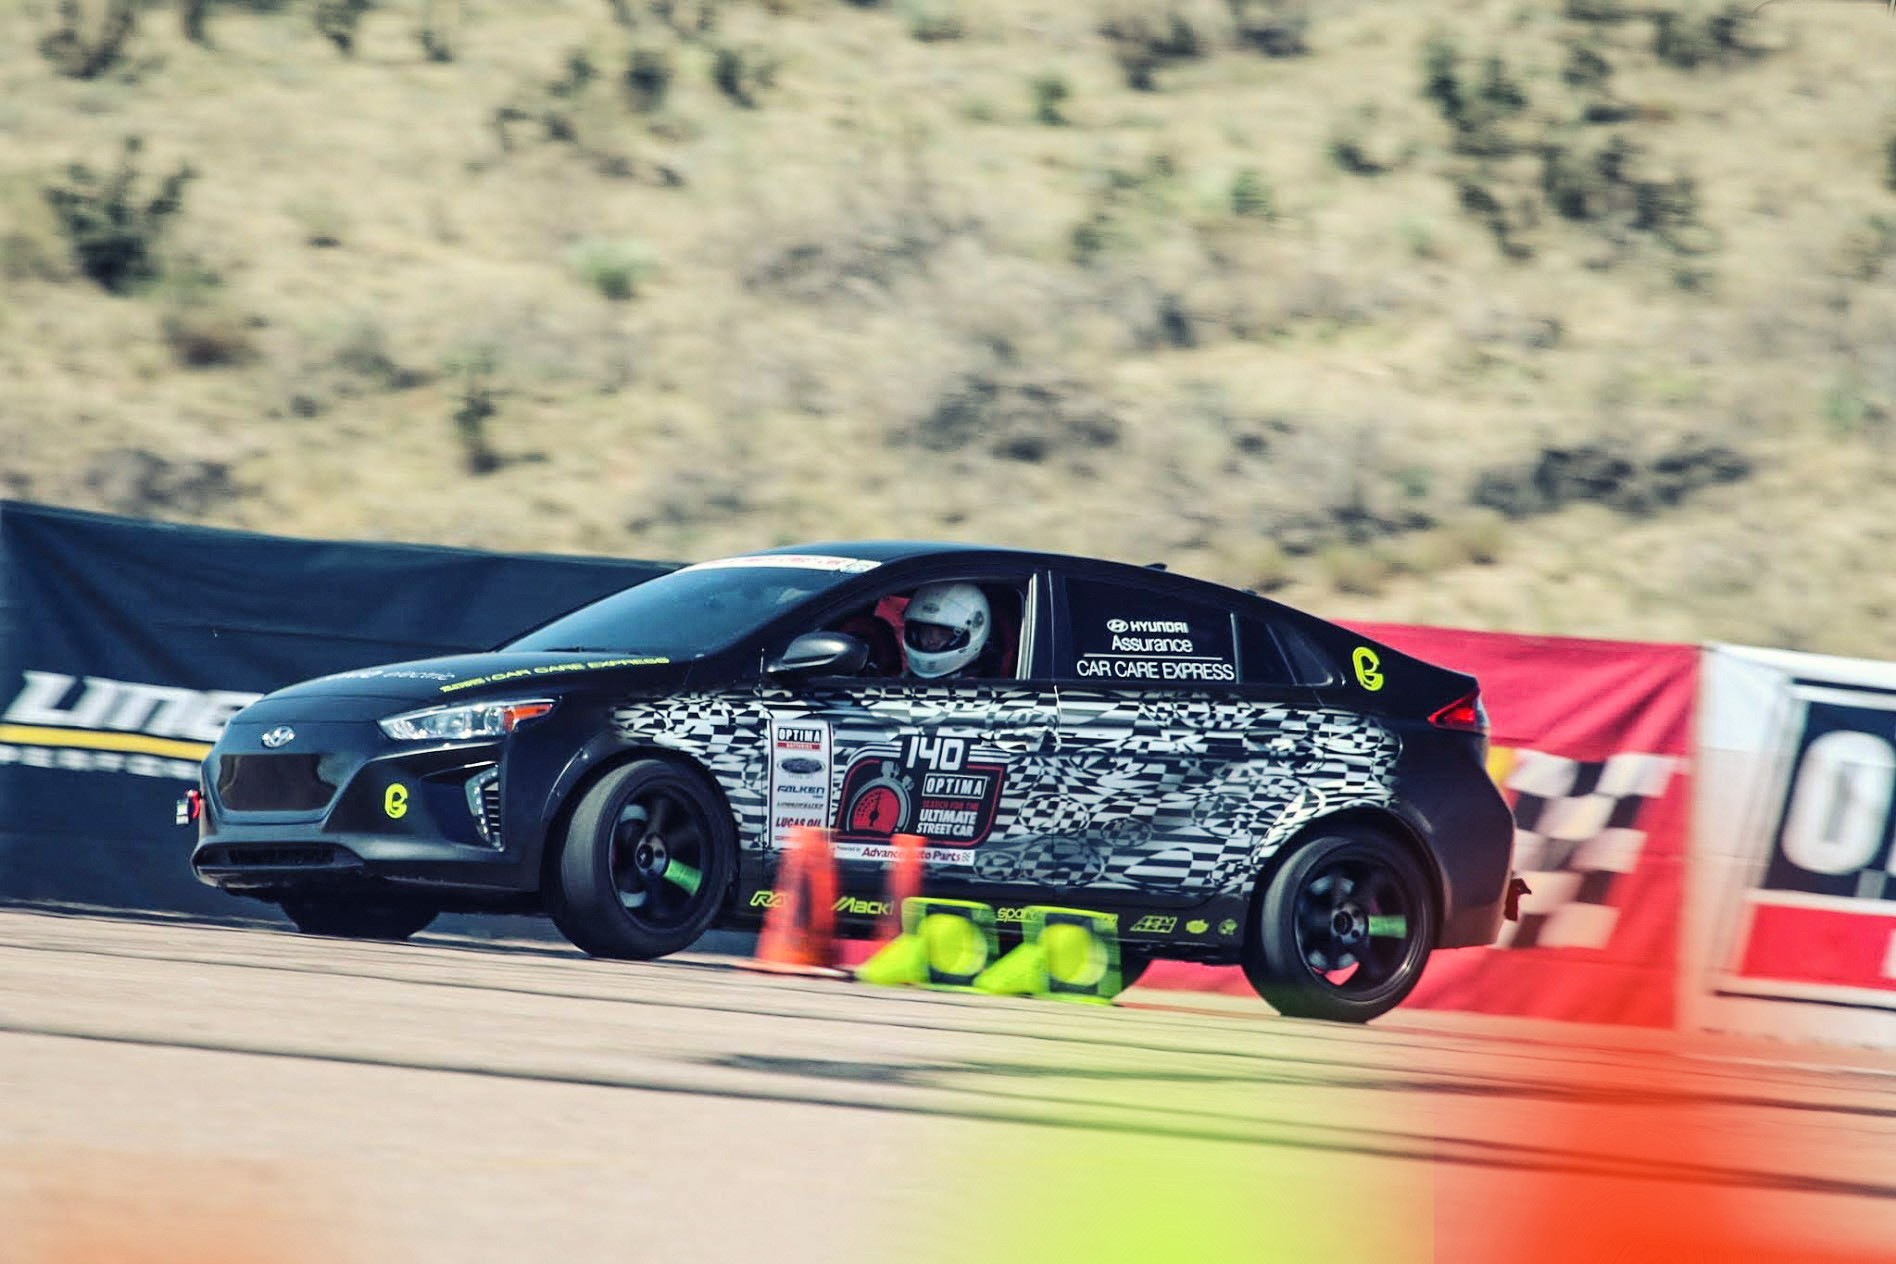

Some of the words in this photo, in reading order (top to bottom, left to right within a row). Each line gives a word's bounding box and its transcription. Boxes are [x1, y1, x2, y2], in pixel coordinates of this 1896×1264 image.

[1130, 621, 1189, 633] HYUNDAI
[1112, 635, 1194, 652] Assurance
[587, 656, 670, 669] EXPRESS
[1076, 660, 1111, 677] CAR
[1114, 661, 1160, 679] CARE
[1162, 662, 1235, 680] EXPRESS
[778, 728, 821, 743] OPTIMA
[906, 736, 964, 771] 140
[777, 785, 825, 795] FALKEN
[925, 777, 982, 796] OPTIMA
[1781, 729, 1896, 877] O
[776, 817, 805, 829] LUCAS
[807, 818, 822, 828] OIL
[919, 808, 978, 825] ULTIMATE
[916, 822, 953, 835] STREET
[952, 824, 975, 837] CAR
[932, 851, 961, 864] Parts
